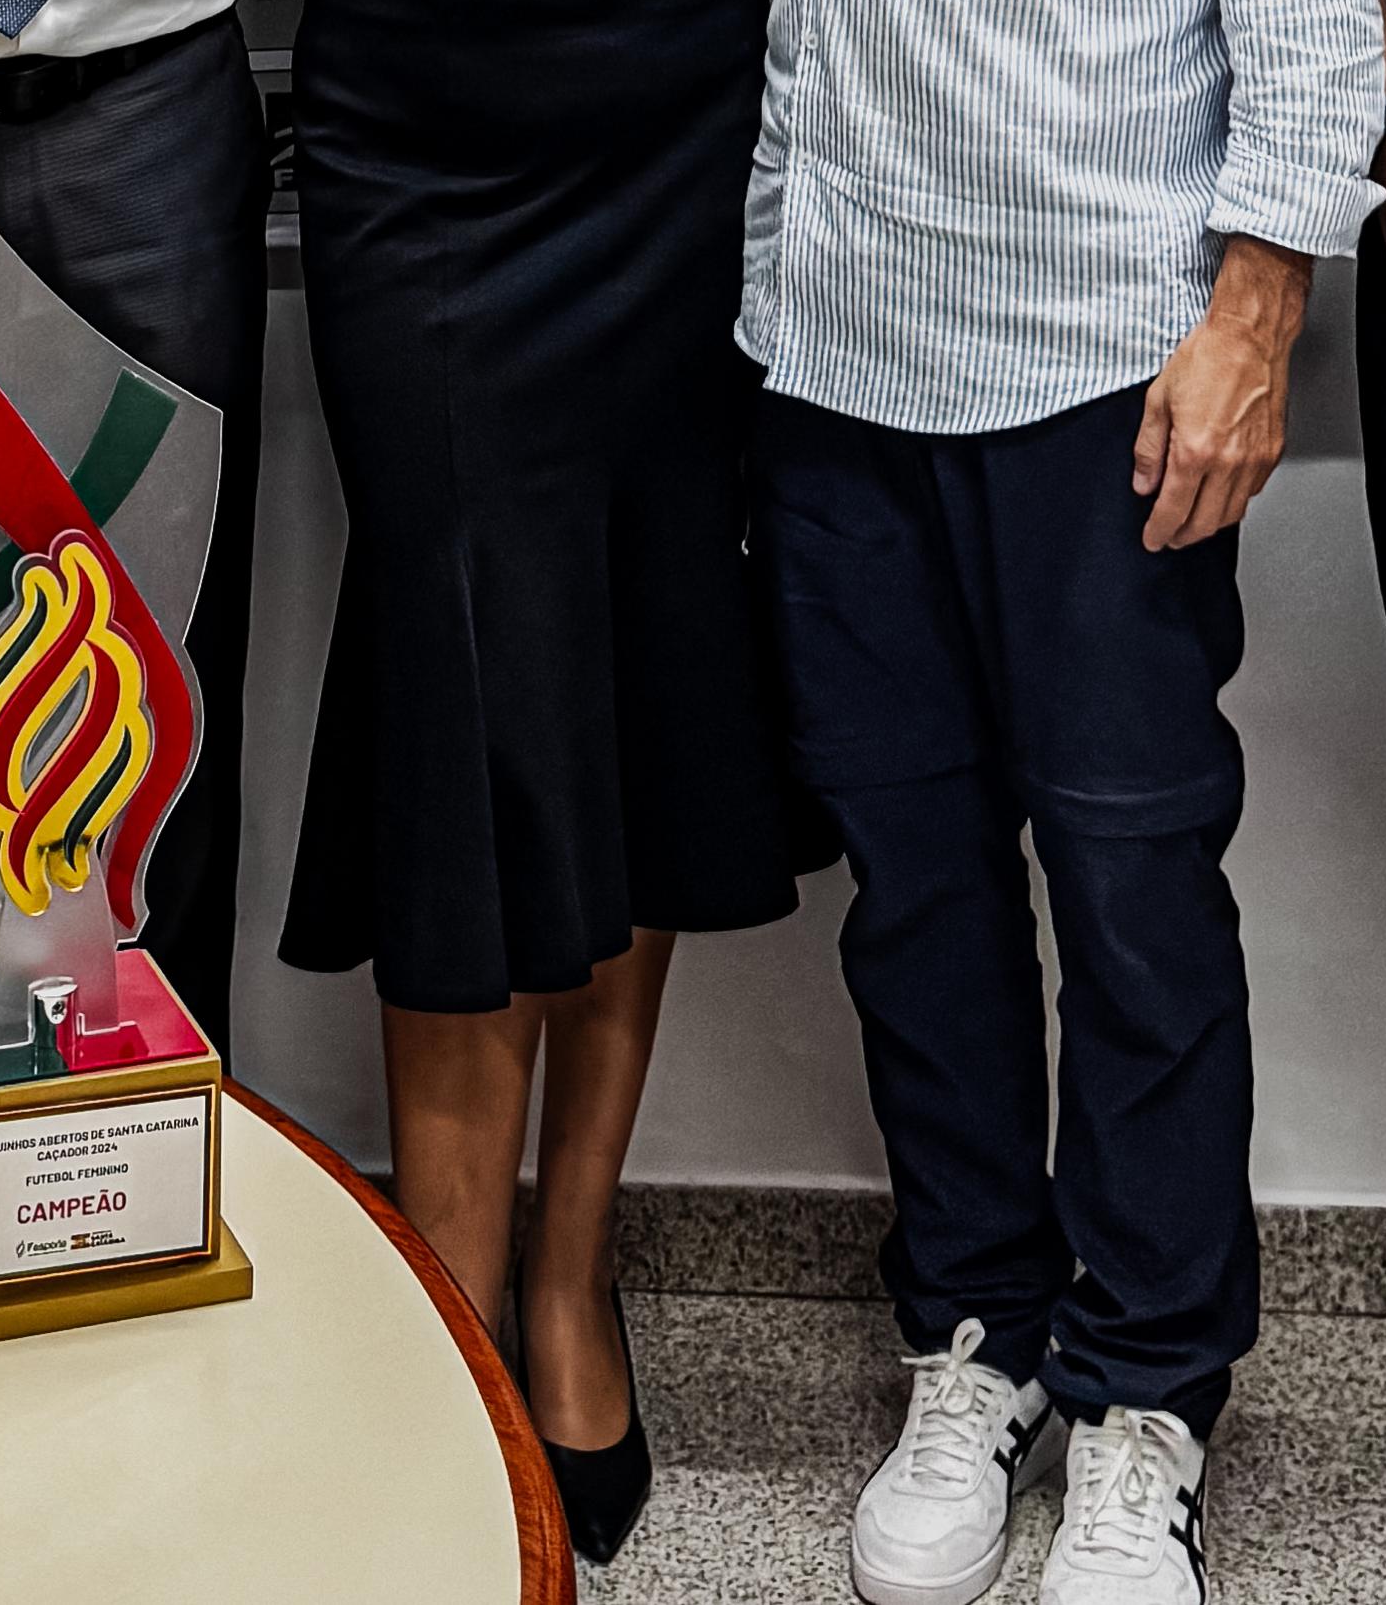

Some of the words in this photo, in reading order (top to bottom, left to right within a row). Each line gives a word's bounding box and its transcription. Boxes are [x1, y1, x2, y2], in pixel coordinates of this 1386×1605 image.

[39, 1130, 89, 1147] ABERTOS
[90, 1129, 106, 1140] DE
[107, 1124, 144, 1138] SANTA
[146, 1117, 199, 1133] CATARINA
[37, 1146, 89, 1162] CAÇADOR
[91, 1142, 118, 1155] 2024
[26, 1170, 75, 1187] FUTEBOL
[78, 1163, 129, 1180] FEMININO
[17, 1189, 127, 1225] CAMPEÃO
